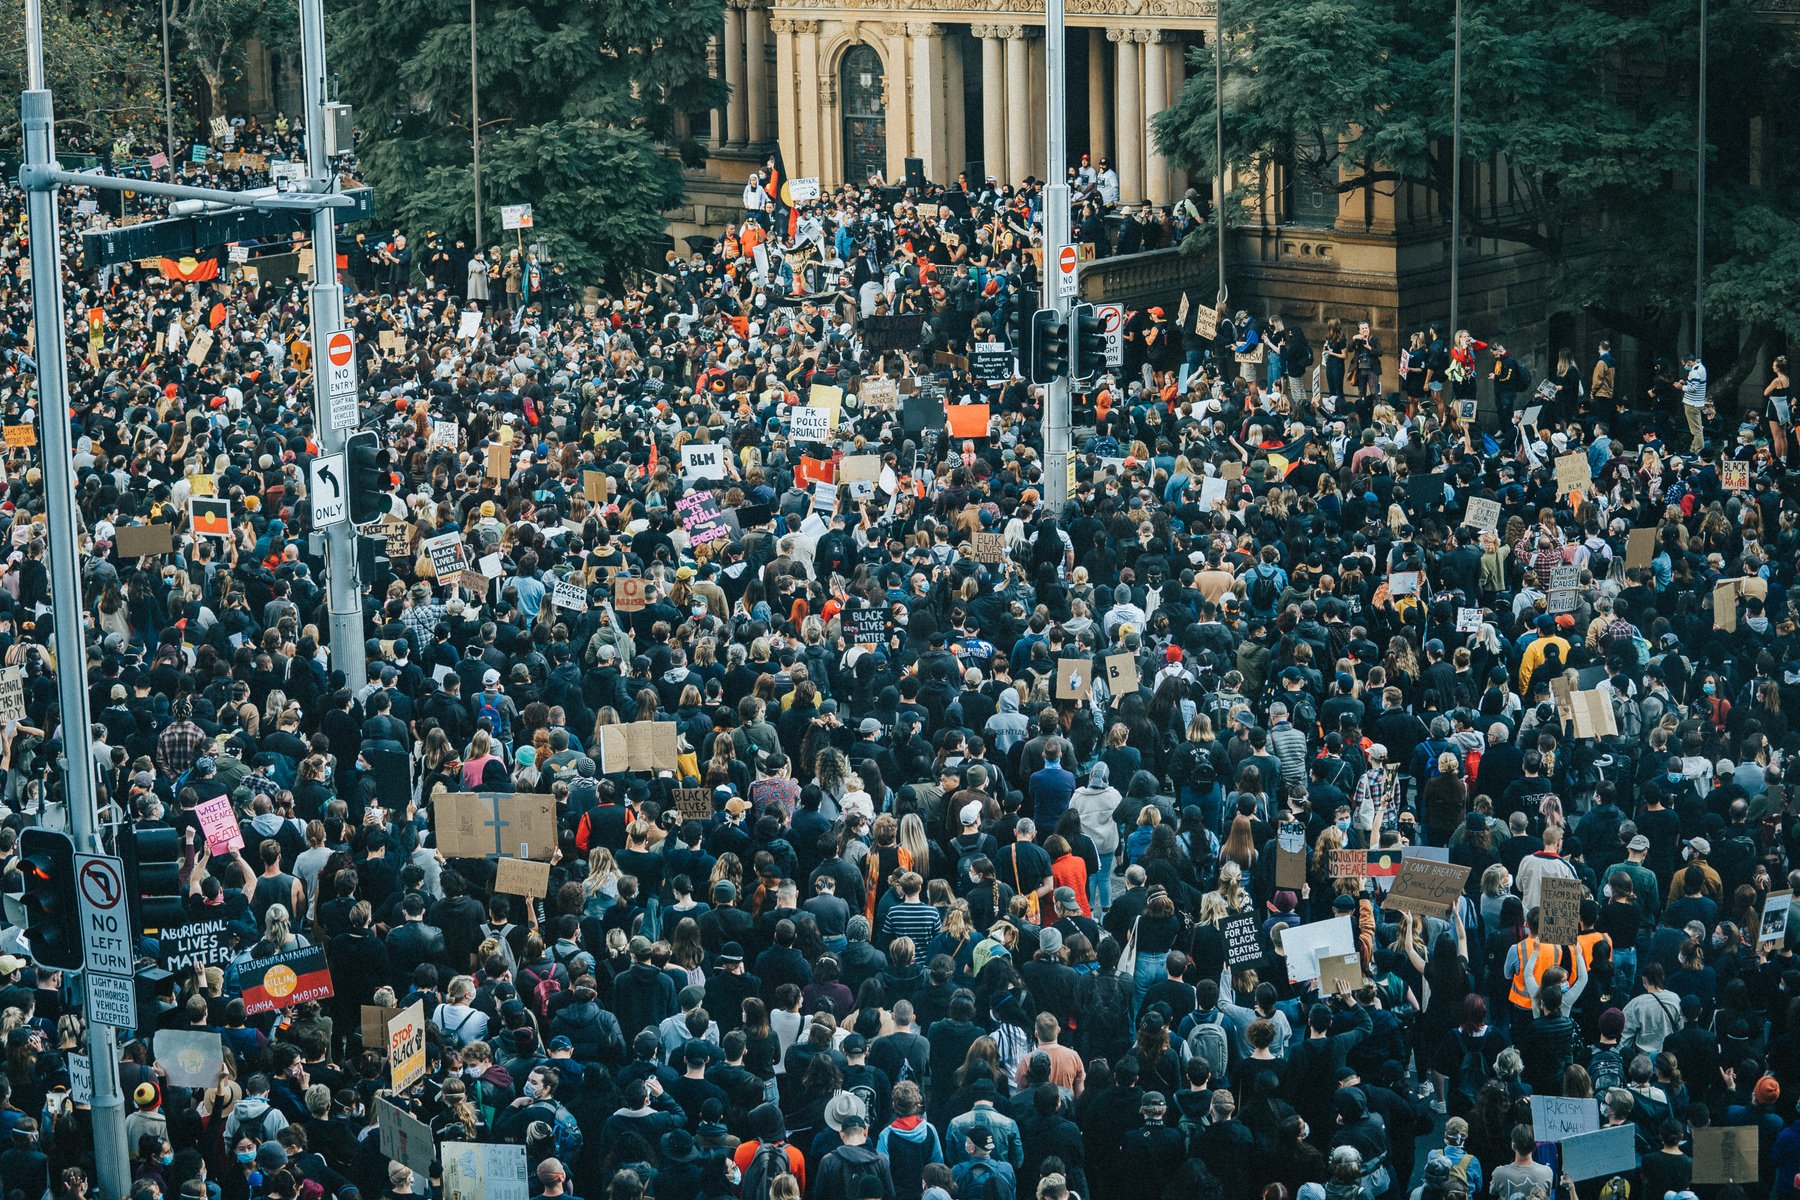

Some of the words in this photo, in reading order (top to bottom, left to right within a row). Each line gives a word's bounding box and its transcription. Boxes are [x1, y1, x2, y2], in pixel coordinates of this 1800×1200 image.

[1063, 276, 1072, 284] NO
[1060, 286, 1076, 294] ENTRY
[1236, 353, 1262, 362] RACISM
[335, 369, 349, 380] NO
[331, 380, 354, 391] ENTRY
[332, 398, 344, 406] LIGHT
[334, 412, 354, 420] VEHICLES
[797, 417, 827, 426] POLICE
[334, 419, 355, 428] EXCEPTED
[690, 453, 715, 466] BLM
[1724, 462, 1746, 472] BLACK
[675, 490, 714, 512] RACISM
[316, 503, 342, 520] ONLY
[688, 503, 703, 515] IS
[683, 508, 721, 530] SMALL
[363, 524, 389, 535] ACCEPT
[690, 524, 728, 546] ENERGY
[978, 534, 1001, 545] BLAK
[433, 546, 457, 558] BLACK
[977, 544, 1003, 554] LIVES
[435, 556, 454, 566] LIVES
[438, 563, 465, 576] MATTER
[853, 610, 884, 621] BLACK
[860, 621, 884, 630] LIVES
[855, 633, 885, 642] MATTER
[1110, 666, 1119, 678] B
[14, 694, 23, 706] IN
[674, 790, 710, 802] BLACK
[198, 800, 227, 816] WHITE
[678, 802, 706, 810] LIVES
[201, 808, 233, 825] SILENCE
[208, 826, 240, 844] DEATH
[1280, 822, 1304, 835] ACAB
[1329, 851, 1338, 862] NO
[1338, 851, 1366, 862] JUSTICE
[1329, 863, 1338, 876] NO
[1340, 863, 1365, 876] PEACE
[1396, 873, 1412, 893] 8
[1427, 878, 1445, 897] 46
[1552, 880, 1580, 890] CANNOT
[1543, 890, 1565, 899] TEACH
[1543, 900, 1578, 911] CHILDREN
[92, 913, 118, 933] NO
[1226, 917, 1254, 930] JUSTICE
[161, 920, 227, 940] ABORIGINAL
[1225, 928, 1240, 938] FOR
[1243, 925, 1258, 934] ALL
[91, 936, 122, 951] LEFT
[178, 935, 218, 952] LIVES
[1230, 934, 1256, 947] BLACK
[1229, 943, 1260, 957] DEATHS
[1236, 951, 1262, 962] CUSTODY
[92, 953, 126, 968] TURN
[168, 947, 231, 971] MATTER
[269, 966, 286, 977] STOP
[92, 977, 111, 988] LIGHT
[113, 980, 128, 991] RAIL
[264, 974, 296, 988] KILLING
[94, 989, 129, 1002] AUTHORISED
[274, 986, 287, 997] US
[292, 986, 329, 1002] MABIDYA
[96, 1000, 129, 1014] VEHICLES
[246, 1000, 274, 1014] GUNHA
[96, 1011, 130, 1025] EXCEPTED
[392, 1024, 412, 1049] STOP
[393, 1037, 414, 1068] BLACK
[1547, 1100, 1583, 1115] RACISM
